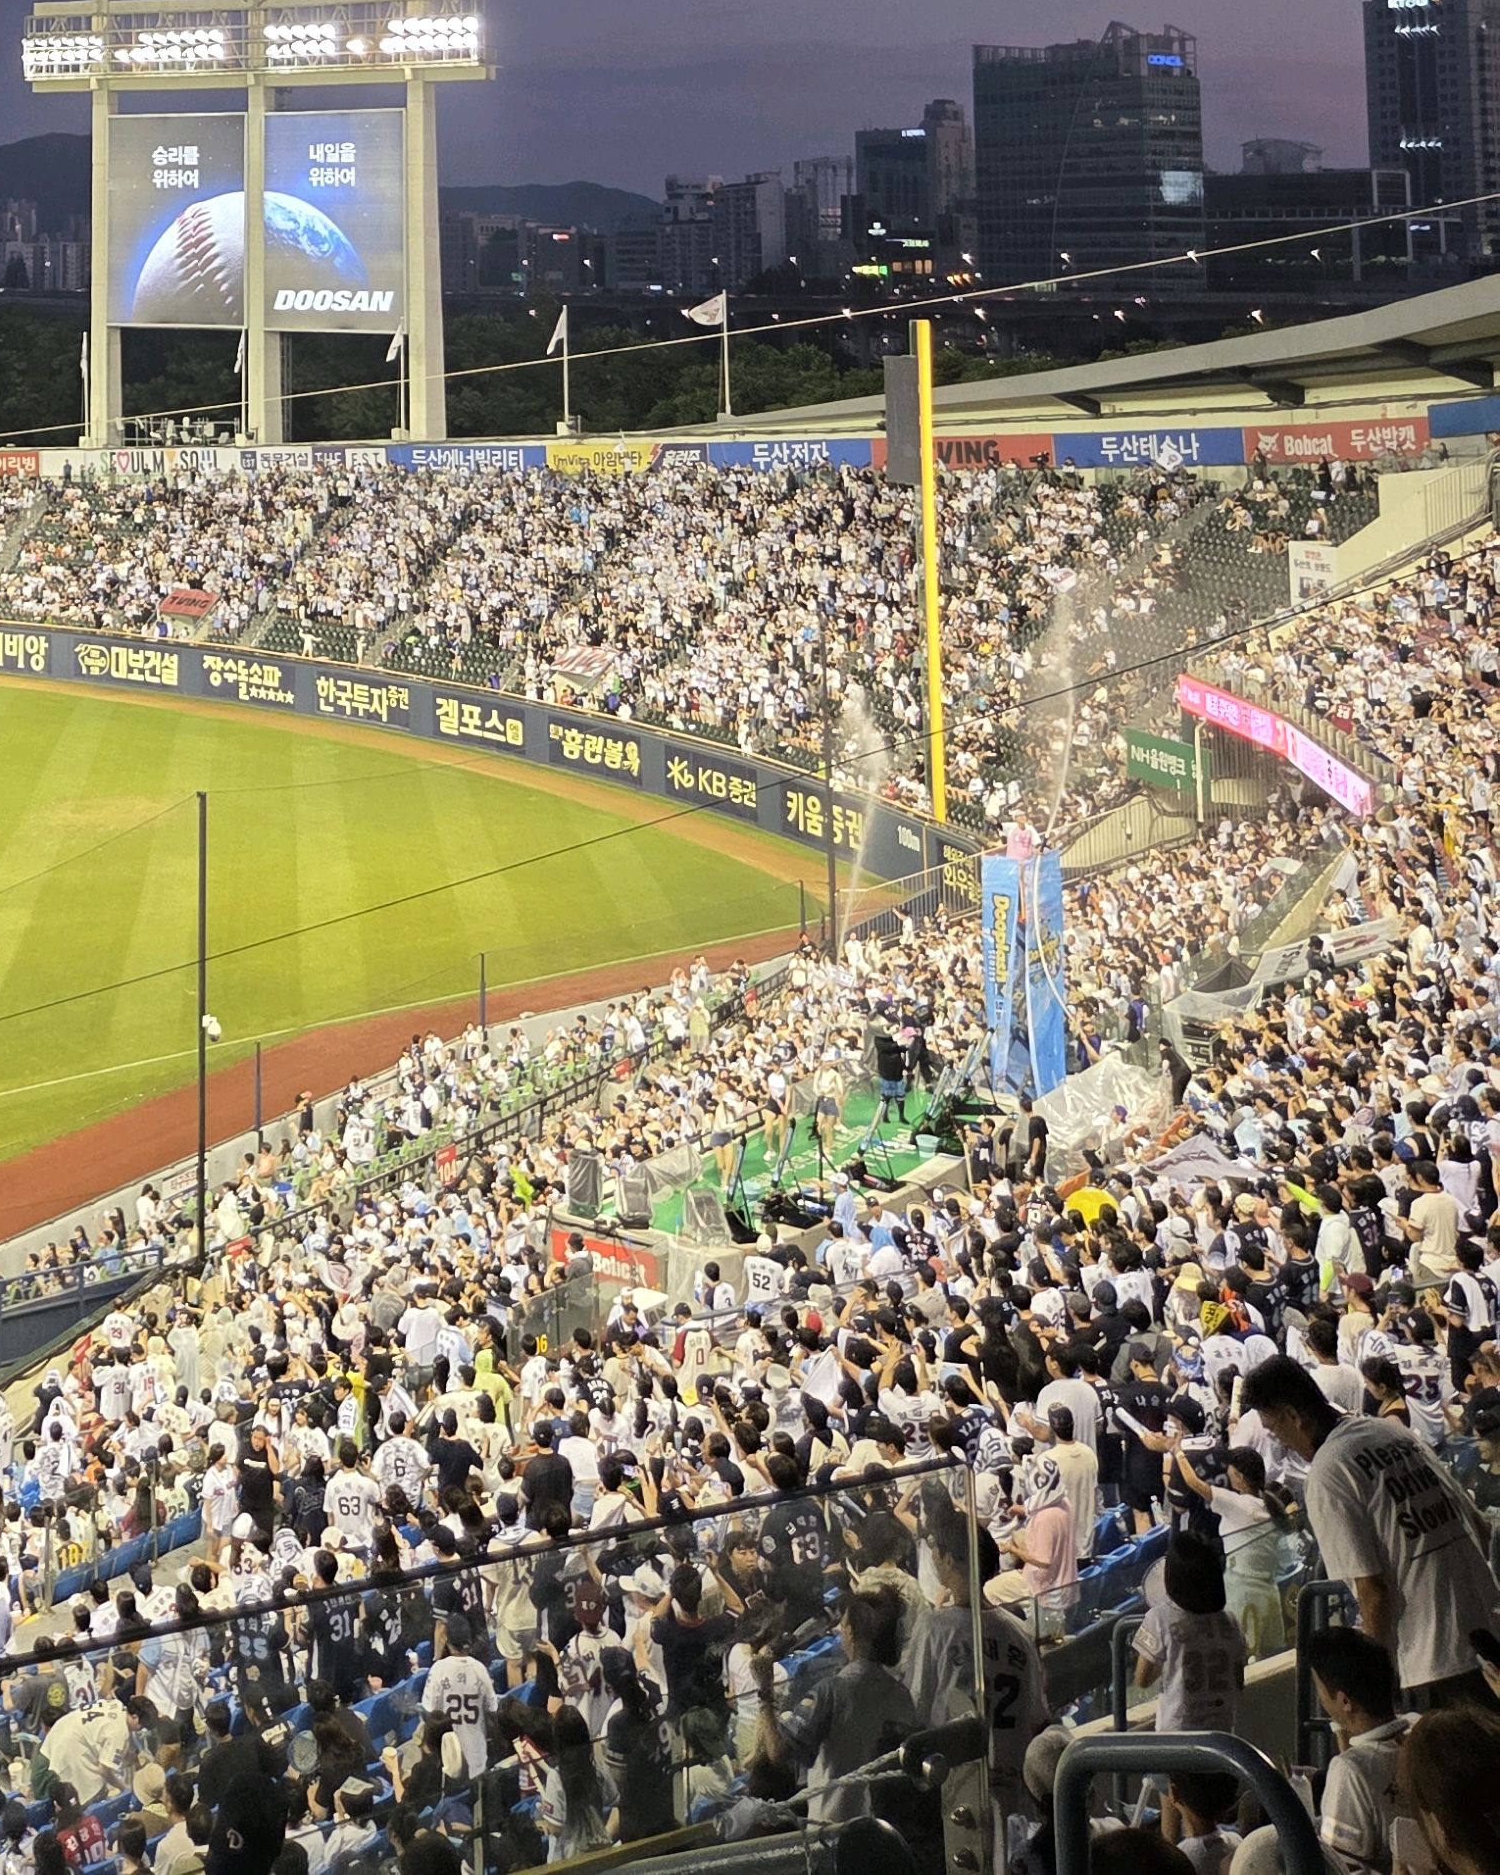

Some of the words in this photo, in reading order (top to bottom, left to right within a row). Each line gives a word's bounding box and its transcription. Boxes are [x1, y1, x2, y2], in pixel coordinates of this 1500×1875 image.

[151, 145, 199, 166] 승리를
[309, 143, 356, 164] 내일을
[152, 169, 199, 189] 위하여
[309, 167, 356, 188] 위하여
[273, 289, 395, 312] DOOSAN
[1284, 434, 1334, 456] Bobcat
[1350, 424, 1416, 452] 두산밥캣
[411, 447, 524, 475] 두산에너빌리티
[752, 442, 829, 470] 두산전자
[933, 439, 999, 464] VING
[168, 595, 211, 610] TVING
[110, 646, 179, 686] 대보건설
[752, 1272, 771, 1291] 52
[1402, 1374, 1441, 1400] 25
[394, 1457, 405, 1477] 6
[1354, 1441, 1419, 1481] Pleas
[337, 1496, 361, 1516] 63
[461, 1583, 479, 1613] 31
[329, 1610, 351, 1642] 31
[238, 1635, 269, 1660] 25
[446, 1693, 480, 1724] 25
